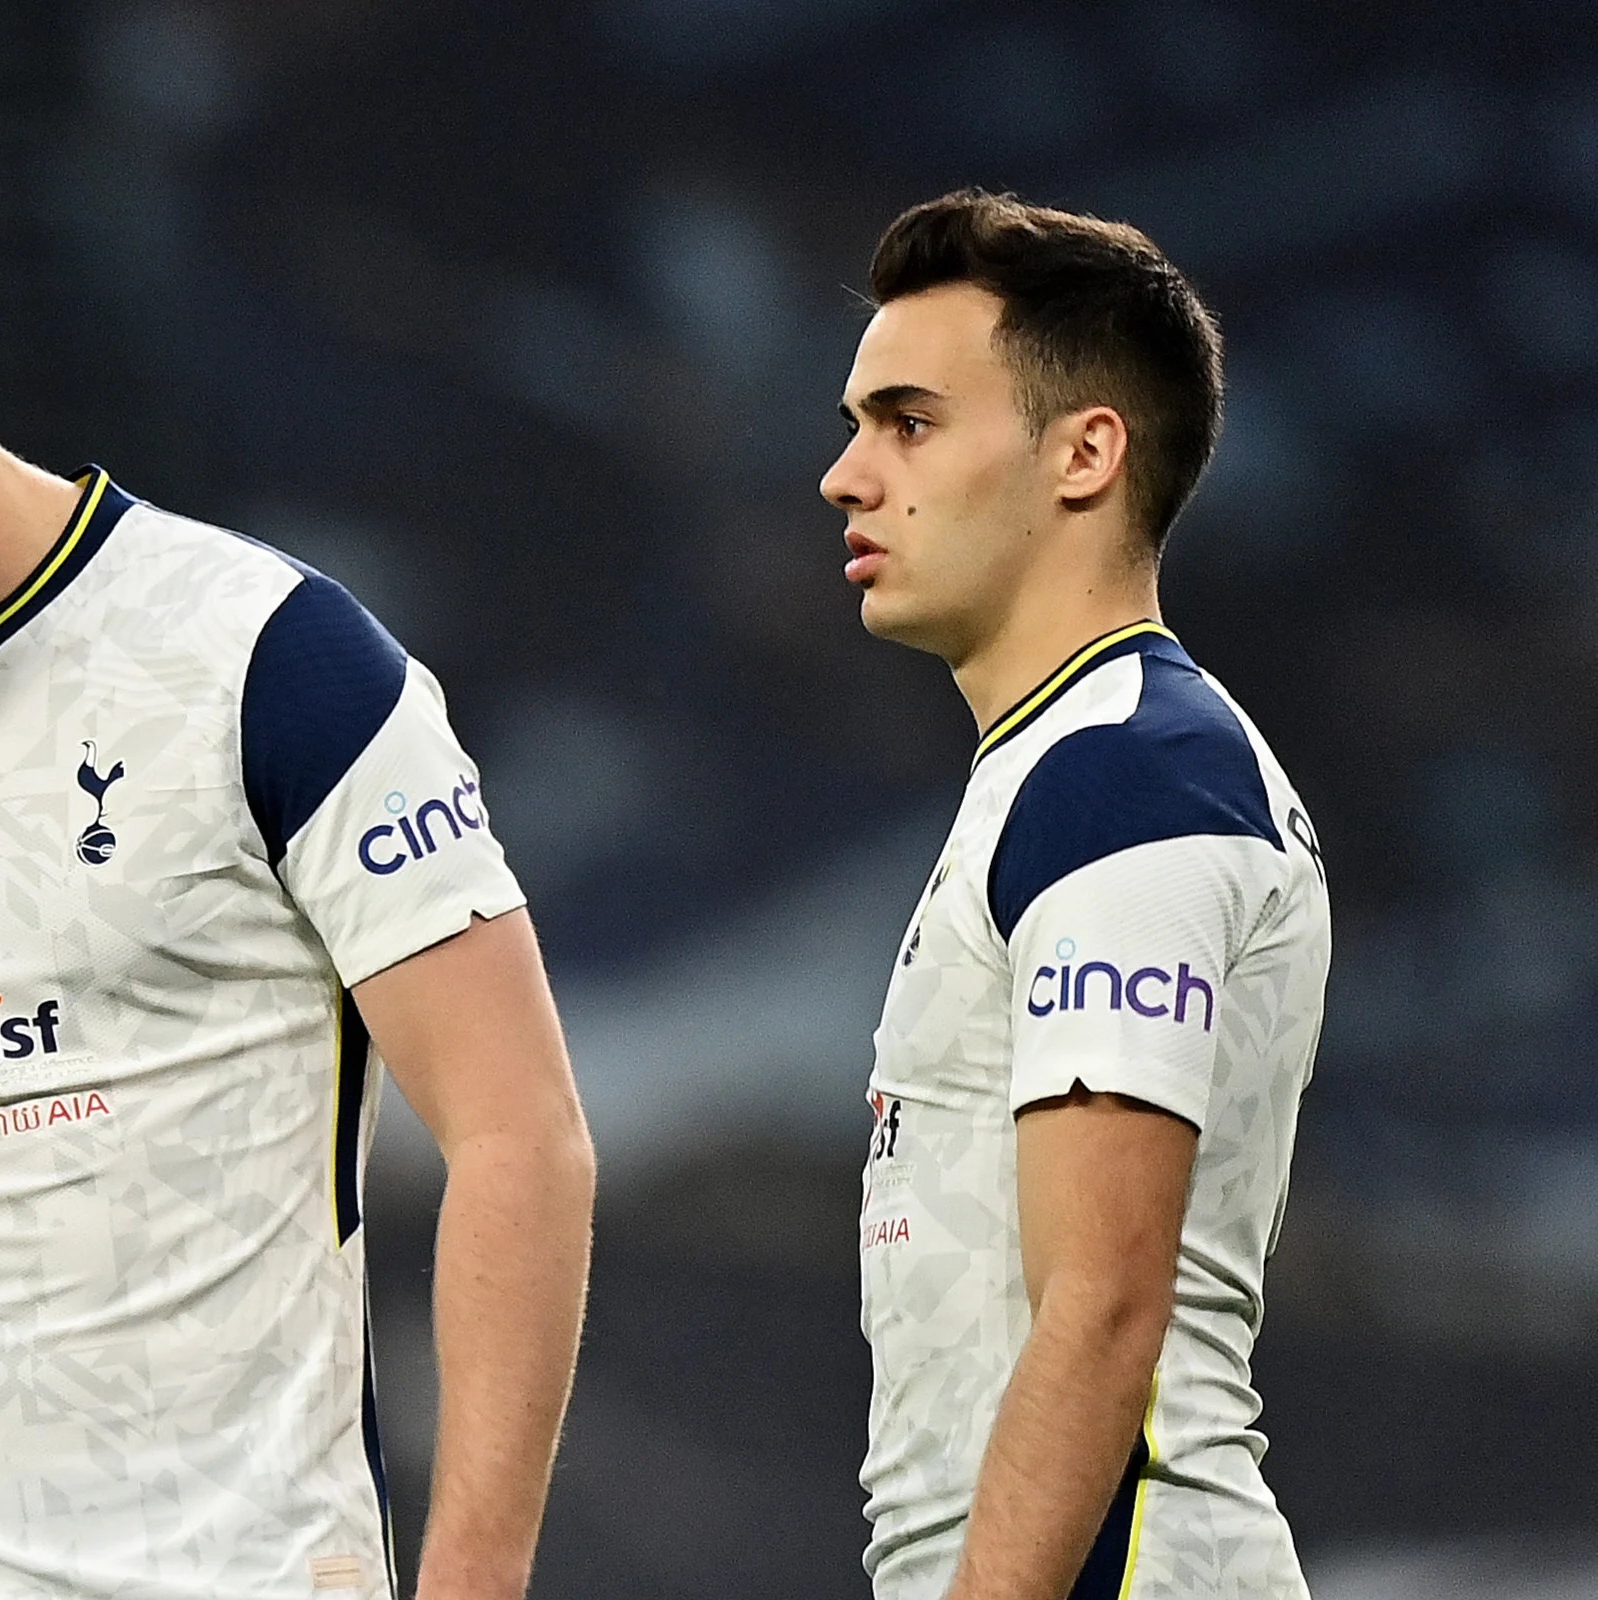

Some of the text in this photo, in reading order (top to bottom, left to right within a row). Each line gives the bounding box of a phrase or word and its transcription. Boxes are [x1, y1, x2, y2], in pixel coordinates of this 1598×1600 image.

[1027, 937, 1214, 1033] cinch
[47, 1092, 111, 1126] AIA
[875, 1217, 910, 1247] AIA
